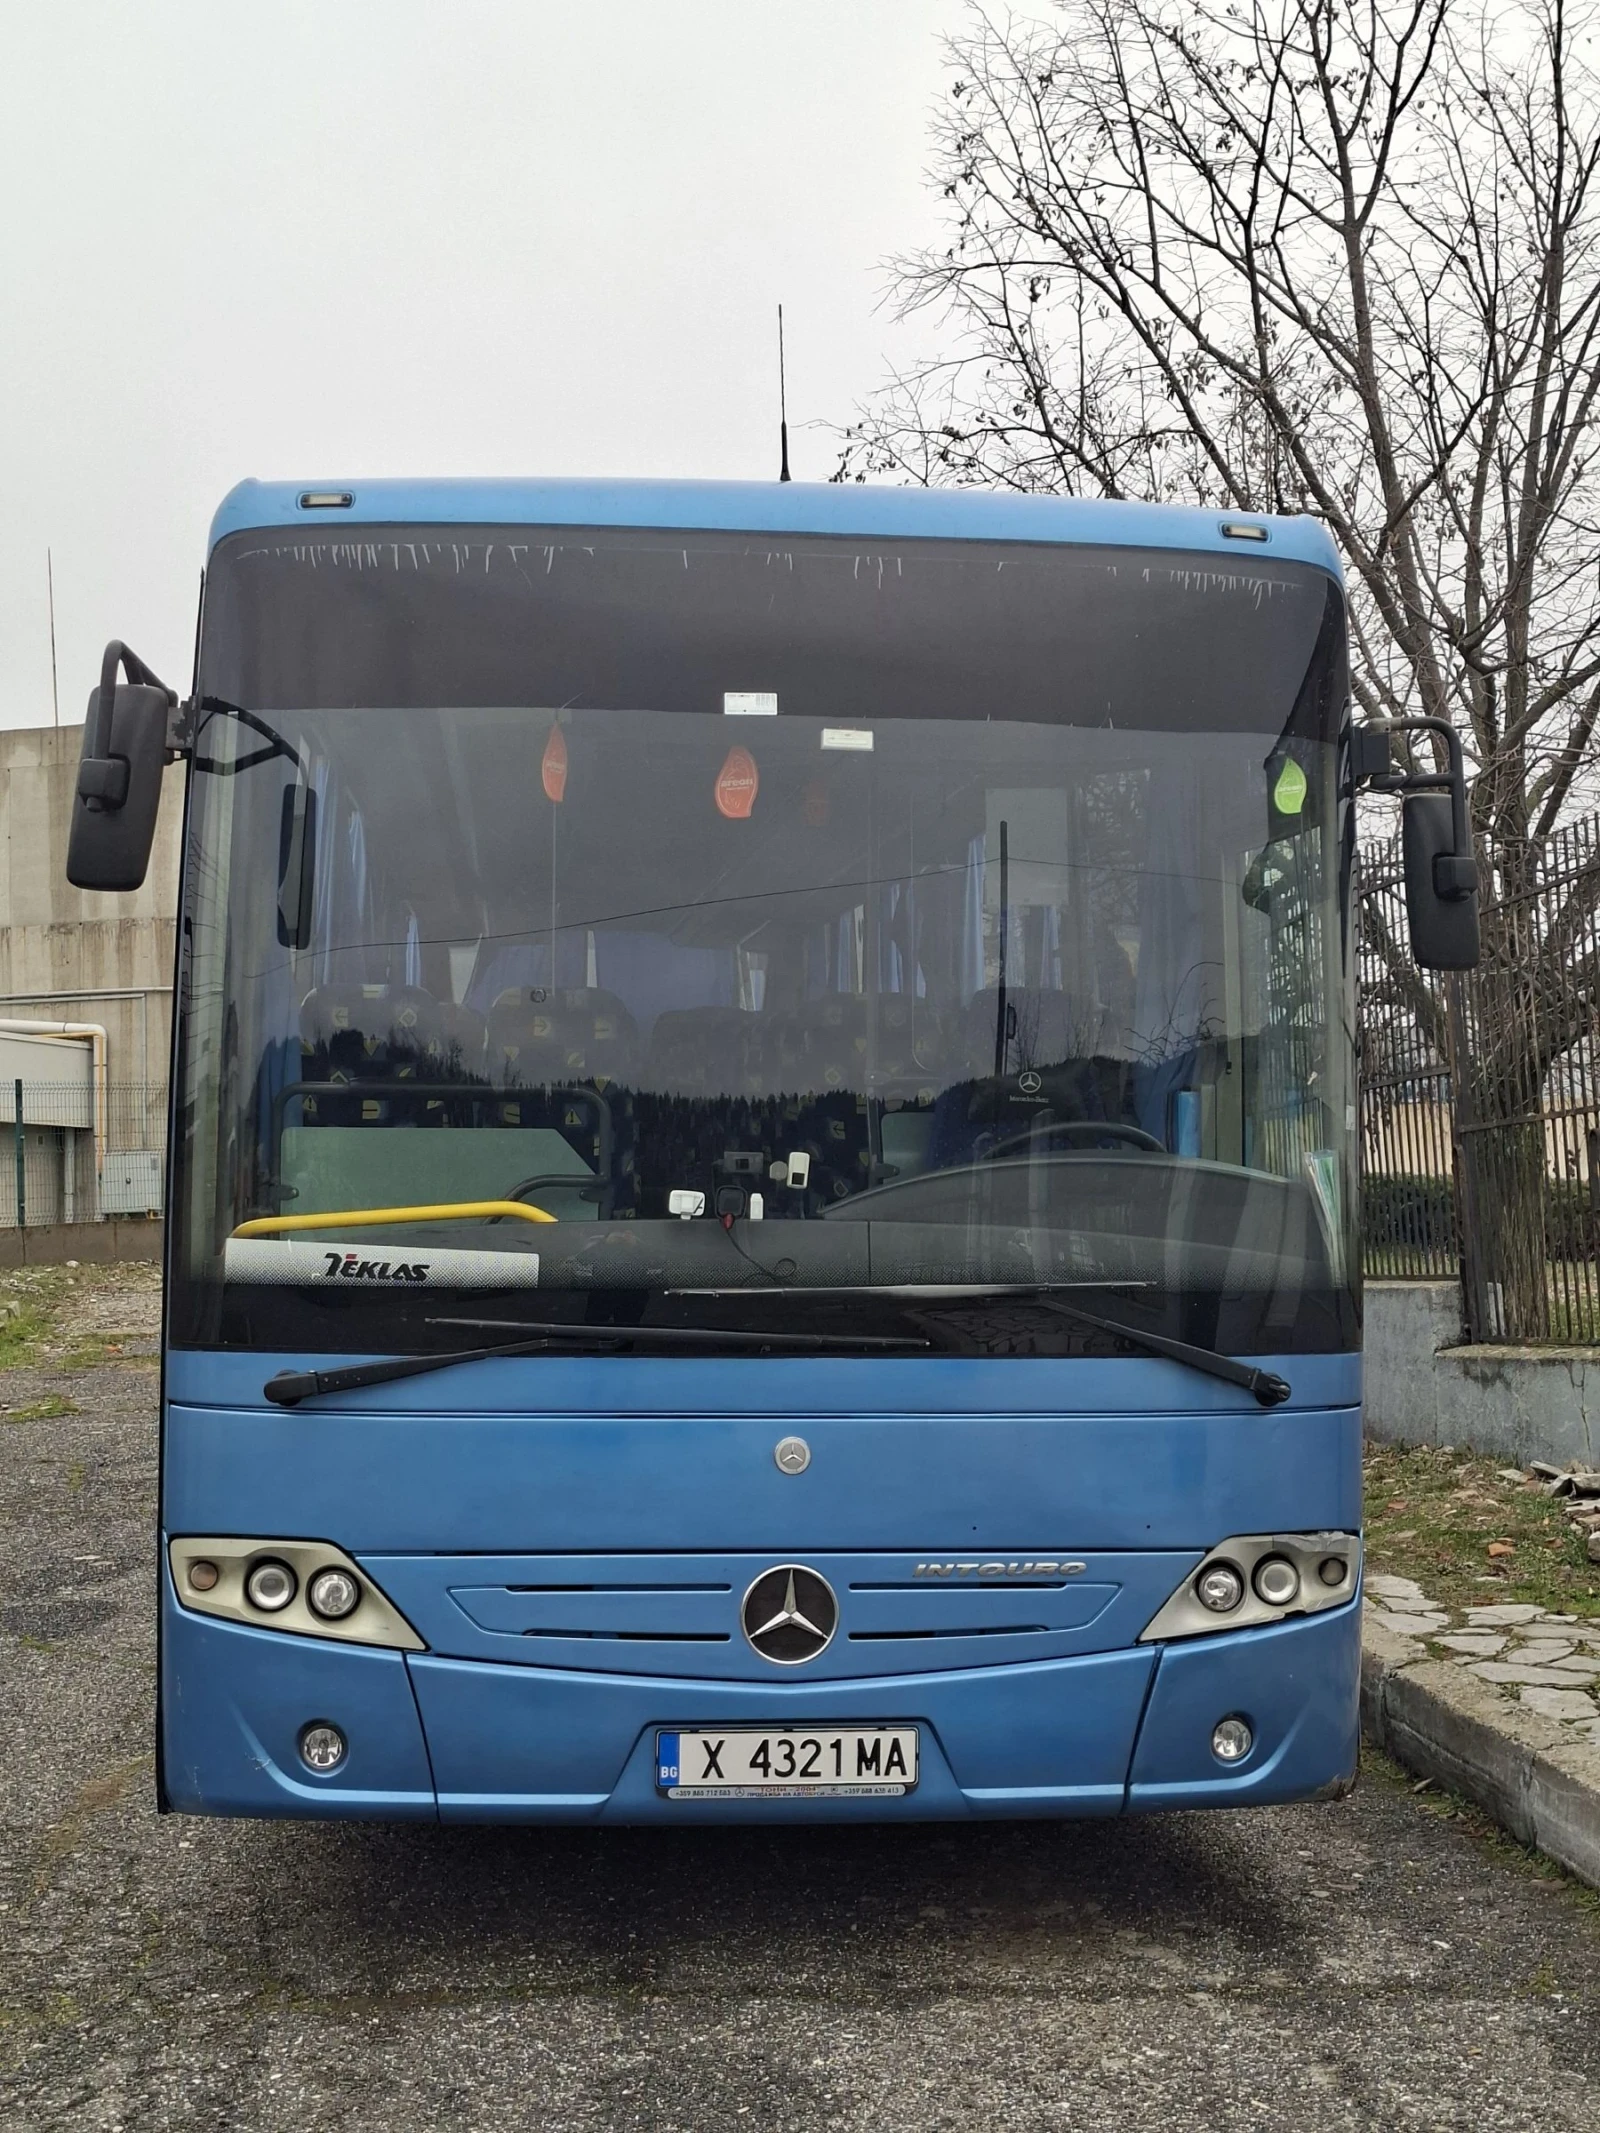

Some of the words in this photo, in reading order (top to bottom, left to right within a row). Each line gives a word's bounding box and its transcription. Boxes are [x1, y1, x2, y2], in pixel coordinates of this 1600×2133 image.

[324, 1252, 430, 1281] TEKLAS
[913, 1561, 1087, 1578] INTOURO
[701, 1739, 725, 1779] X
[749, 1738, 842, 1778] 4321
[856, 1737, 907, 1777] MA
[660, 1766, 678, 1778] BG
